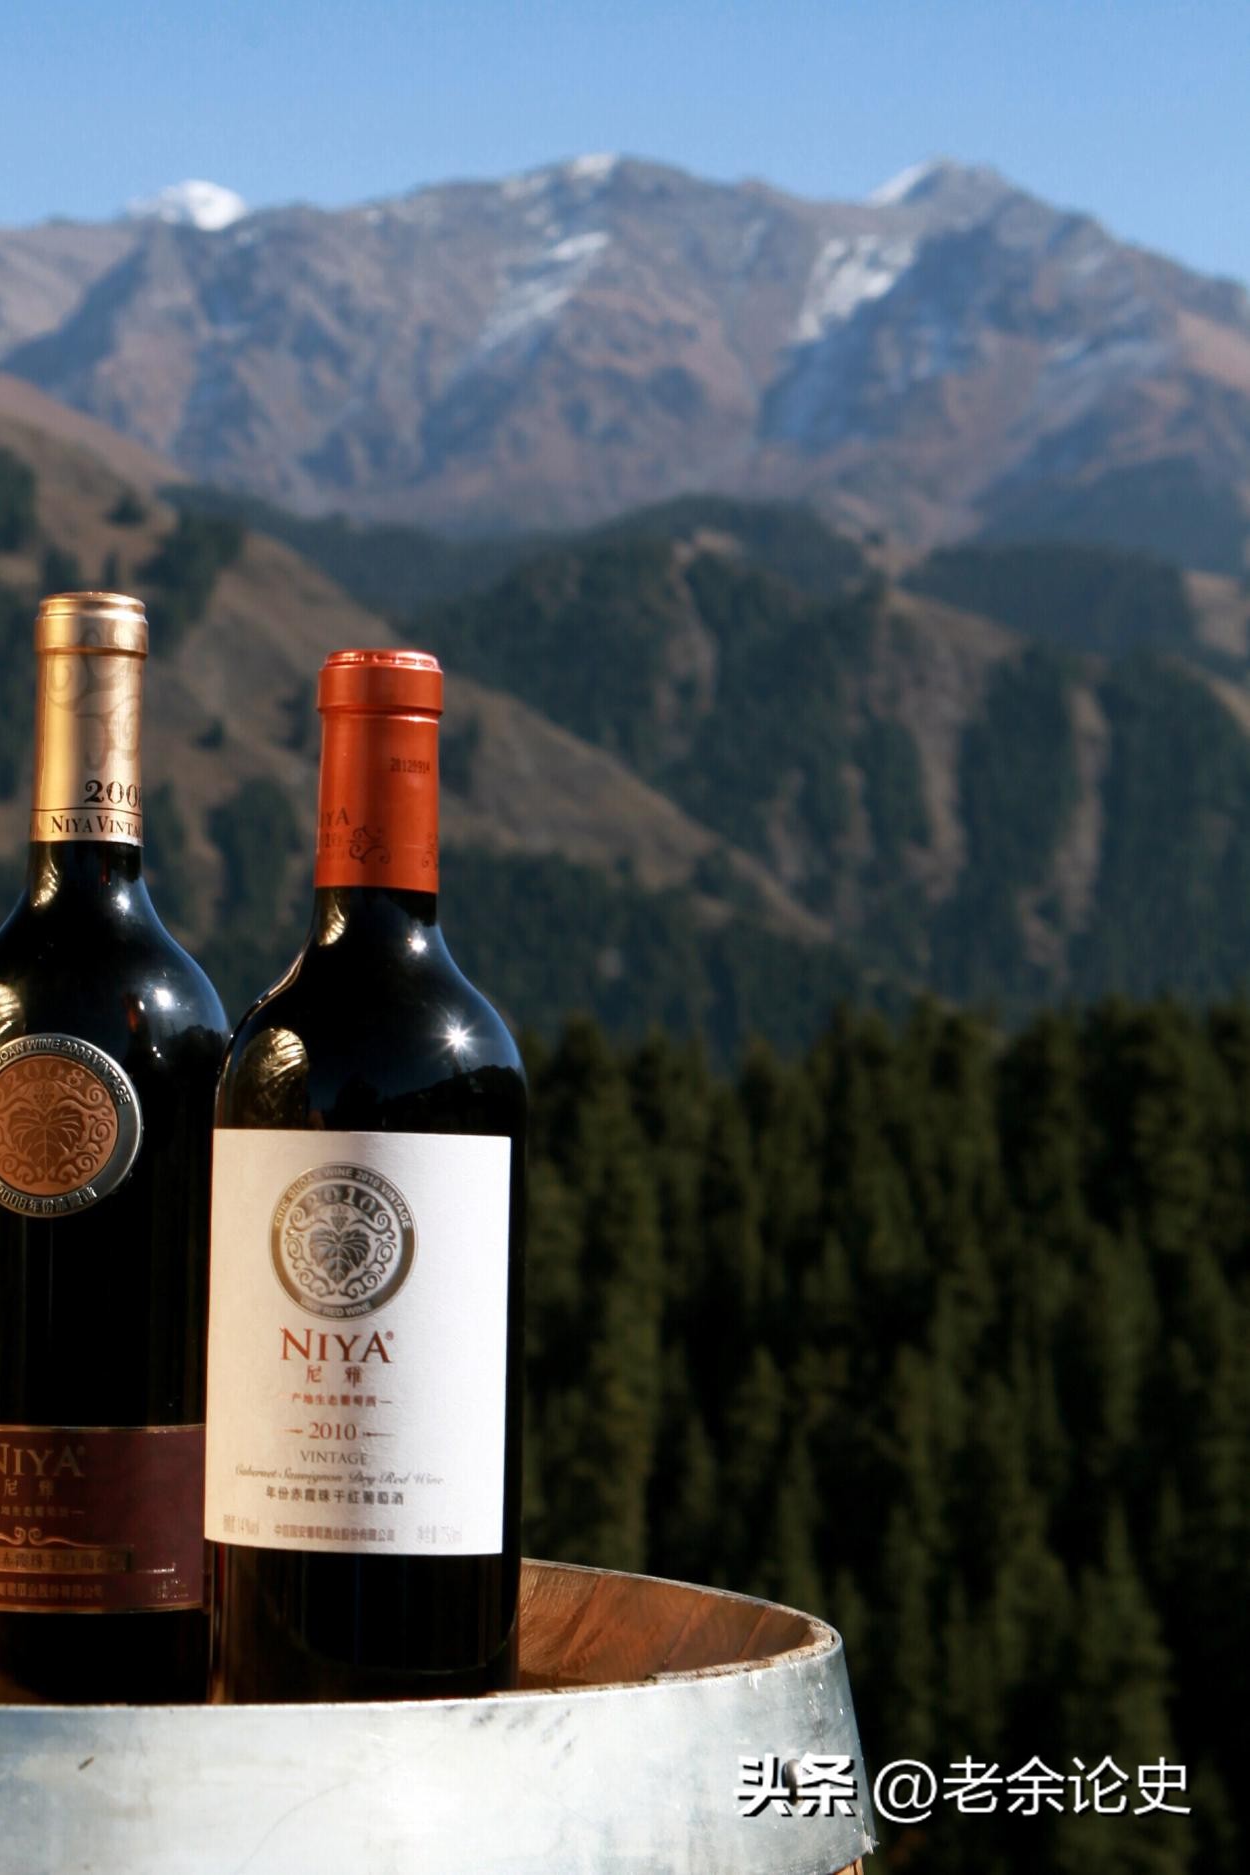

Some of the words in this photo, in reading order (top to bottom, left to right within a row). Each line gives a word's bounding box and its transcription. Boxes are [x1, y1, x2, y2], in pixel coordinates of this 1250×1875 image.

[84, 780, 142, 809] 200
[51, 815, 93, 834] NIYA
[96, 815, 142, 839] VINTA
[2, 1060, 86, 1087] 2008
[27, 1037, 61, 1050] WINE
[91, 1053, 132, 1105] VINTAGE
[324, 1167, 353, 1179] WINE
[355, 1170, 380, 1187] 2010
[378, 1183, 413, 1230] VINTAGE
[306, 1364, 364, 1388] 尼雅
[308, 1422, 357, 1441] 2010
[300, 1450, 368, 1466] VINTAGE
[234, 1463, 278, 1479] Cabernet
[278, 1467, 343, 1484] Sauvignon
[379, 1472, 410, 1485] Red
[266, 1485, 404, 1505] 年份赤霞珠干红葡萄酒
